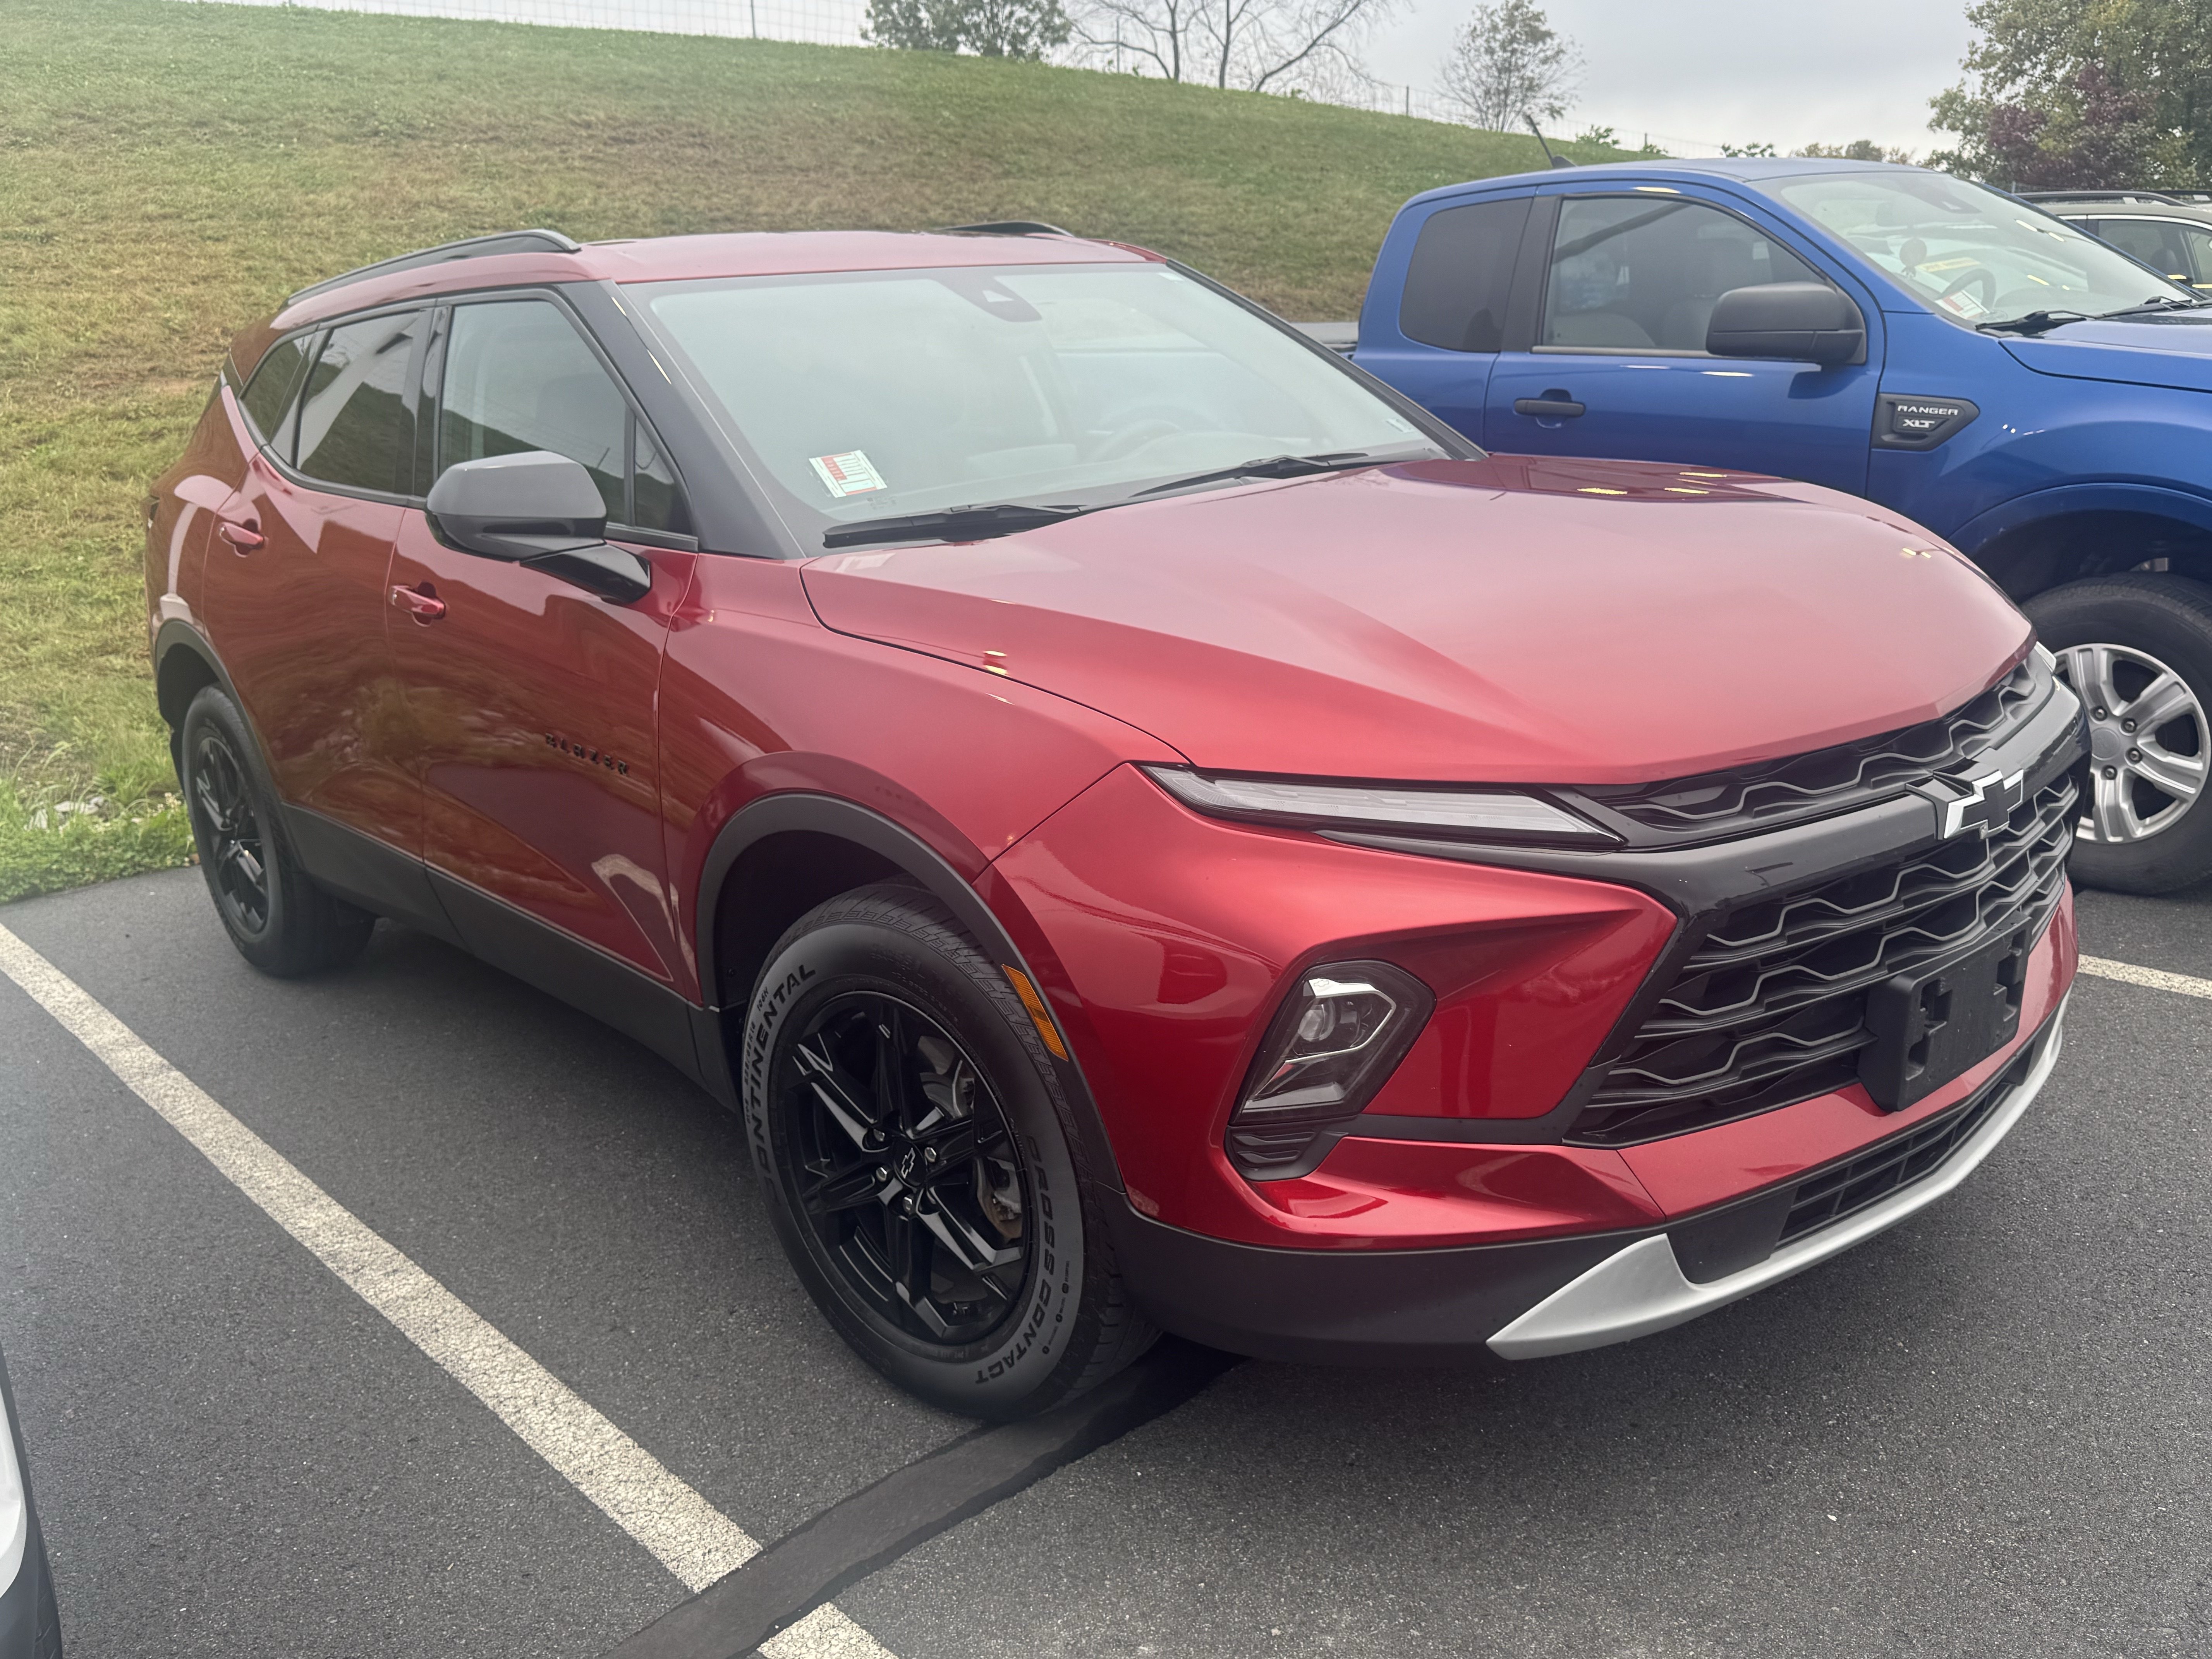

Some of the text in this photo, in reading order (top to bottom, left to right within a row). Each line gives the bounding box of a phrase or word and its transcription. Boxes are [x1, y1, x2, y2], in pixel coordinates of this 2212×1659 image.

[1897, 405, 1958, 416] RANGER
[1902, 419, 1935, 428] XLT
[545, 733, 629, 777] BLAZER
[750, 964, 816, 1206] CONTINENTAL
